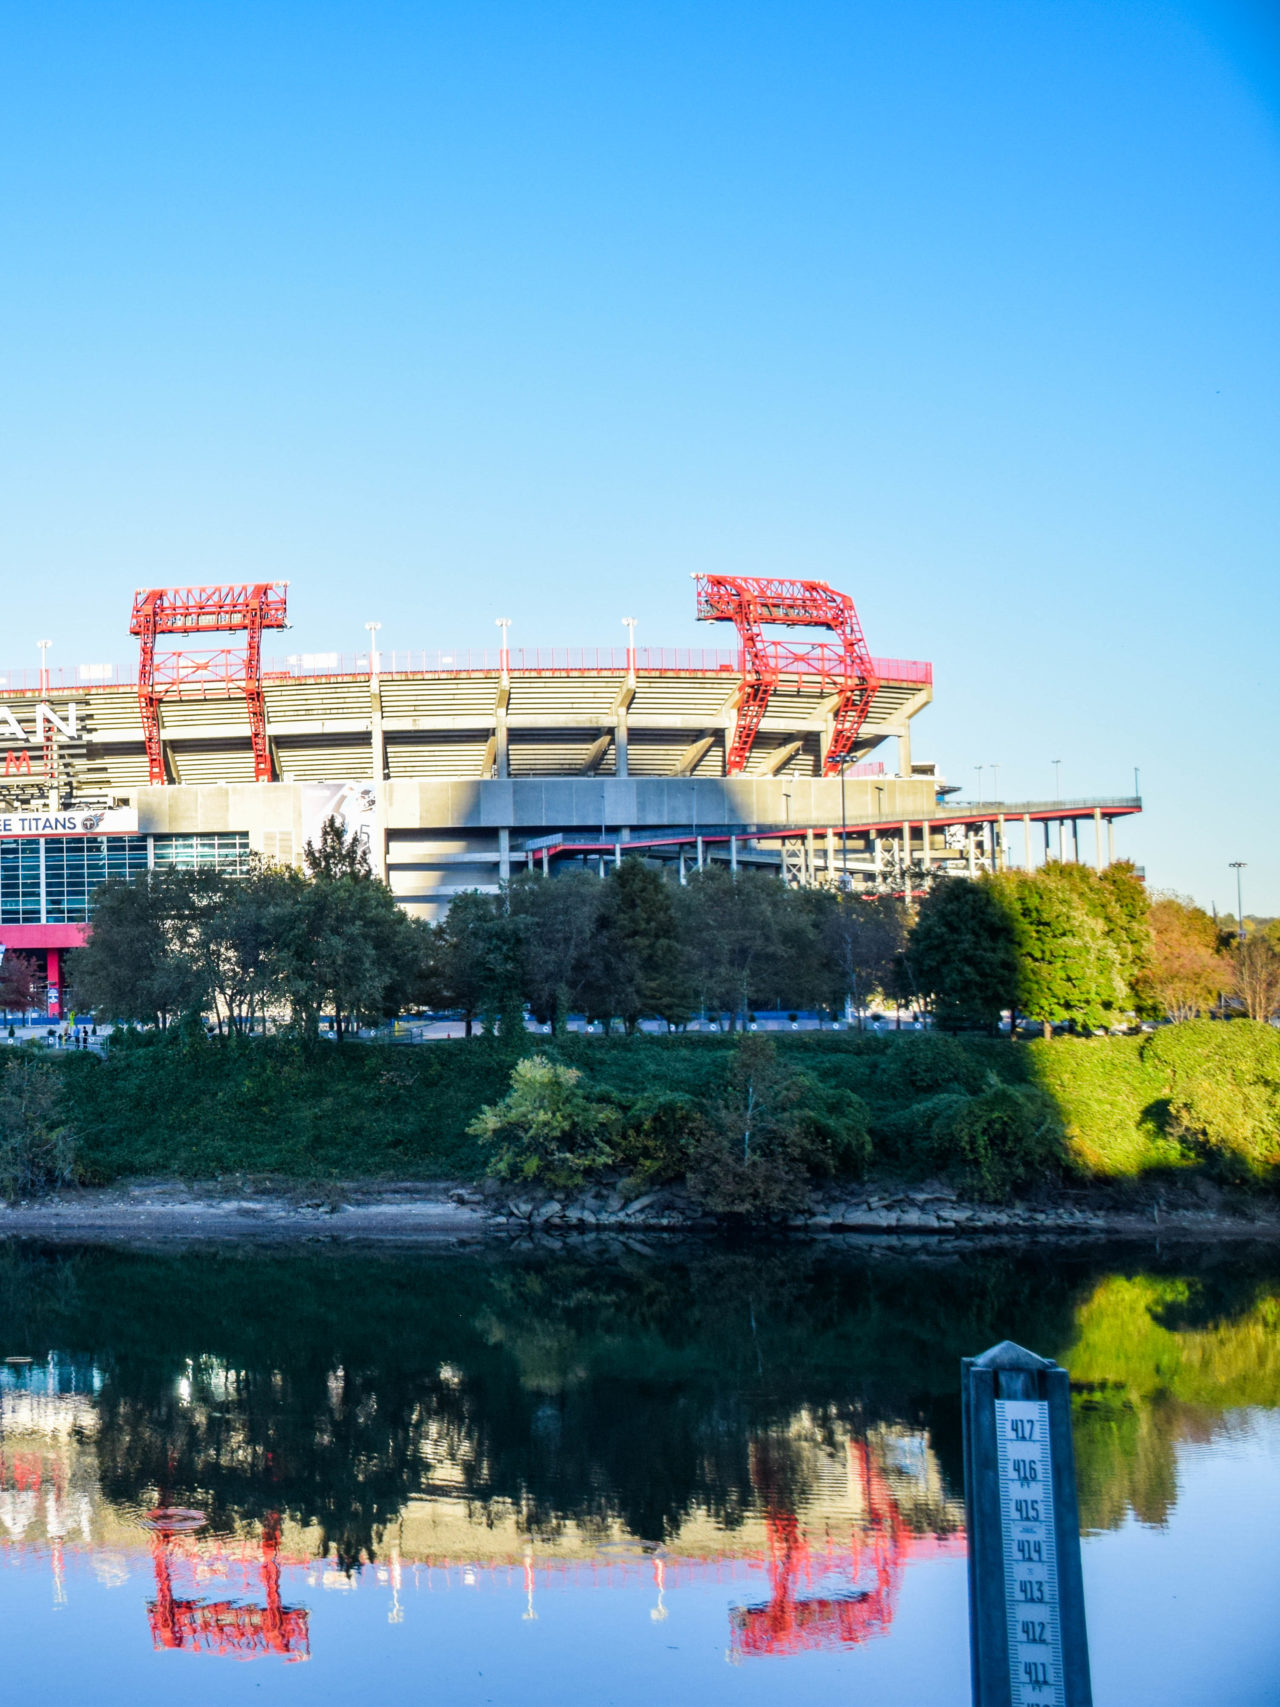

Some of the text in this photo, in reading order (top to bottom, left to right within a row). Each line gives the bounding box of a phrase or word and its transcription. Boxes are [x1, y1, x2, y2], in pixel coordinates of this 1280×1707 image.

[19, 817, 77, 832] TITANS
[1011, 1419, 1034, 1440] 417
[1013, 1459, 1037, 1481] 416
[1015, 1500, 1039, 1521] 415
[1018, 1540, 1042, 1561] 414
[1020, 1580, 1044, 1601] 413
[1022, 1621, 1046, 1642] 412
[1025, 1662, 1049, 1684] 411
